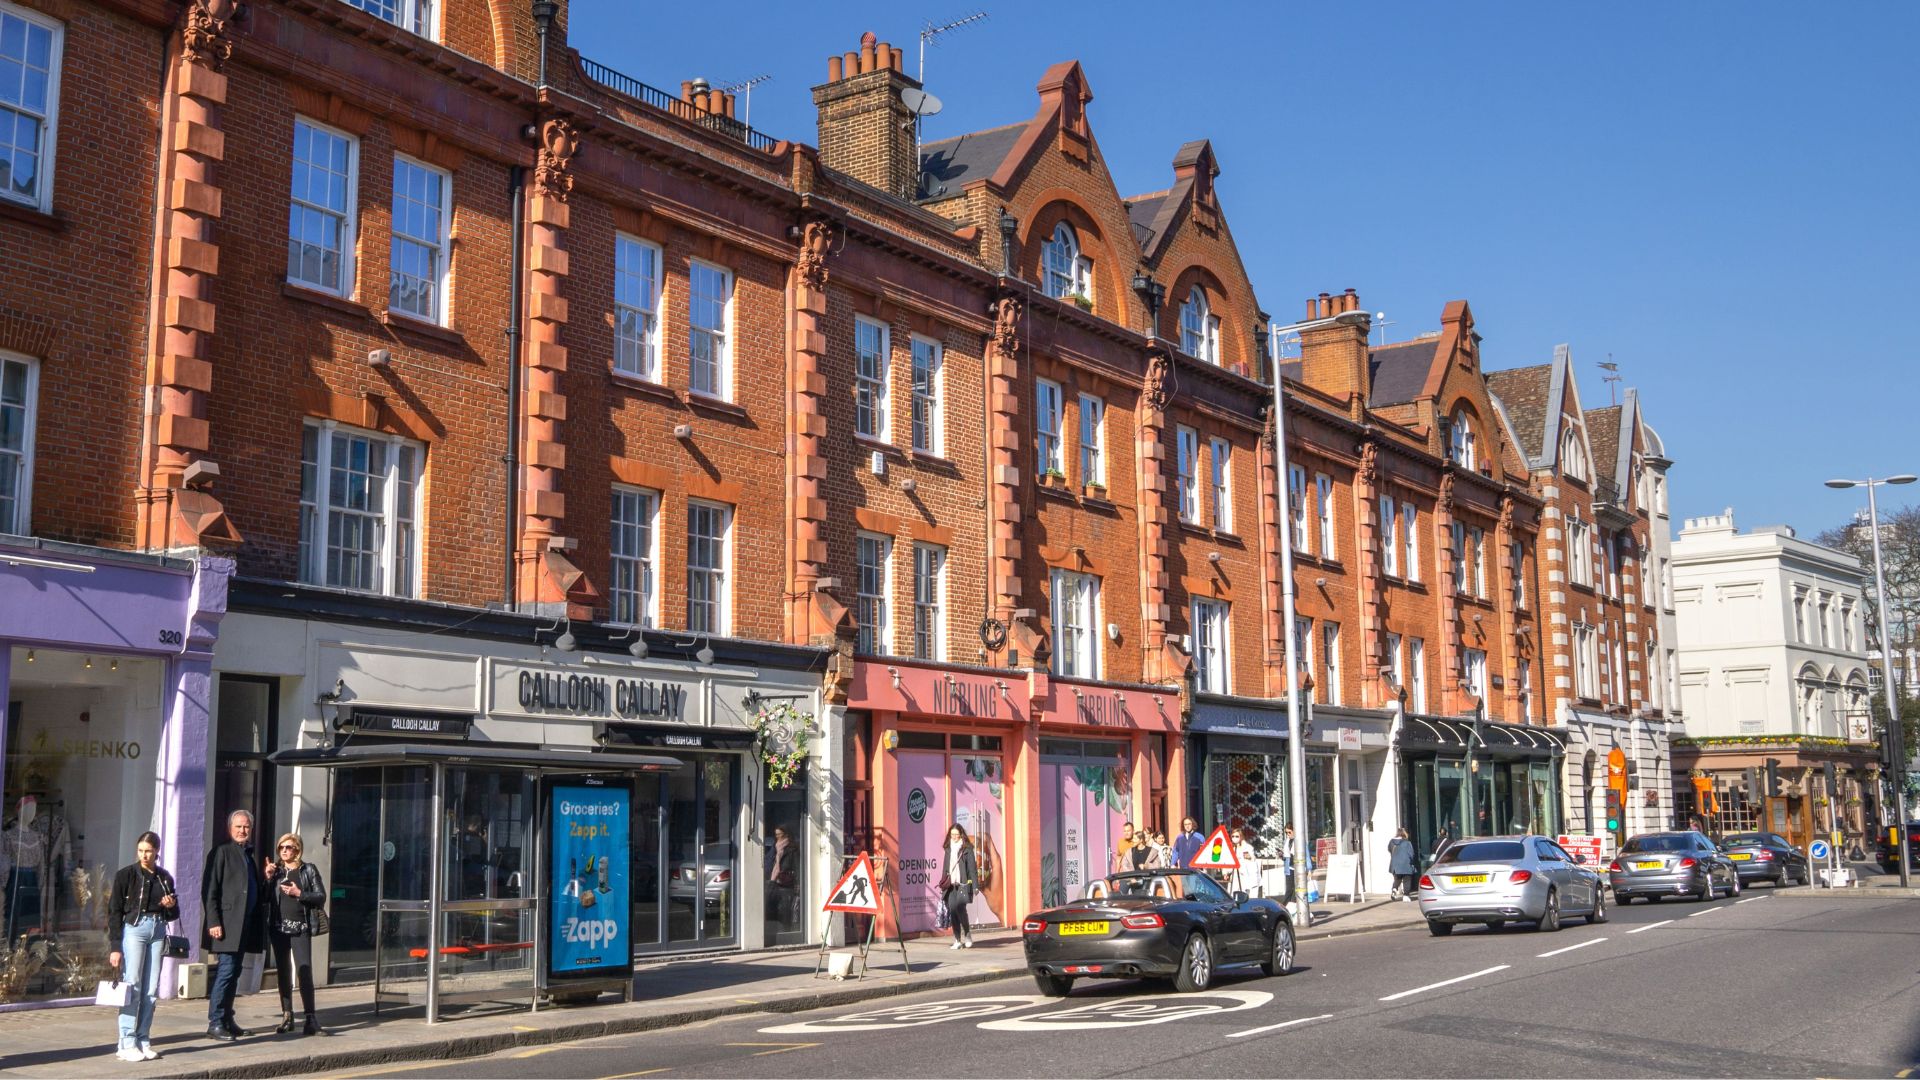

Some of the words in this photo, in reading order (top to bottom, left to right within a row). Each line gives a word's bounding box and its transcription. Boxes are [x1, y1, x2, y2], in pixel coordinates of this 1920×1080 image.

[159, 629, 182, 645] 320
[518, 670, 605, 713] CALLOOH
[615, 678, 682, 717] CALLAY
[933, 679, 997, 718] NIBBLING
[391, 718, 418, 730] CALLOOH
[418, 719, 440, 731] CALLAY
[560, 800, 620, 816] Groceries?
[570, 821, 597, 840] Zapp
[899, 858, 937, 871] OPENING
[906, 872, 930, 885] SOON
[566, 917, 618, 950] Zapp
[1038, 1004, 1223, 1020] 20
